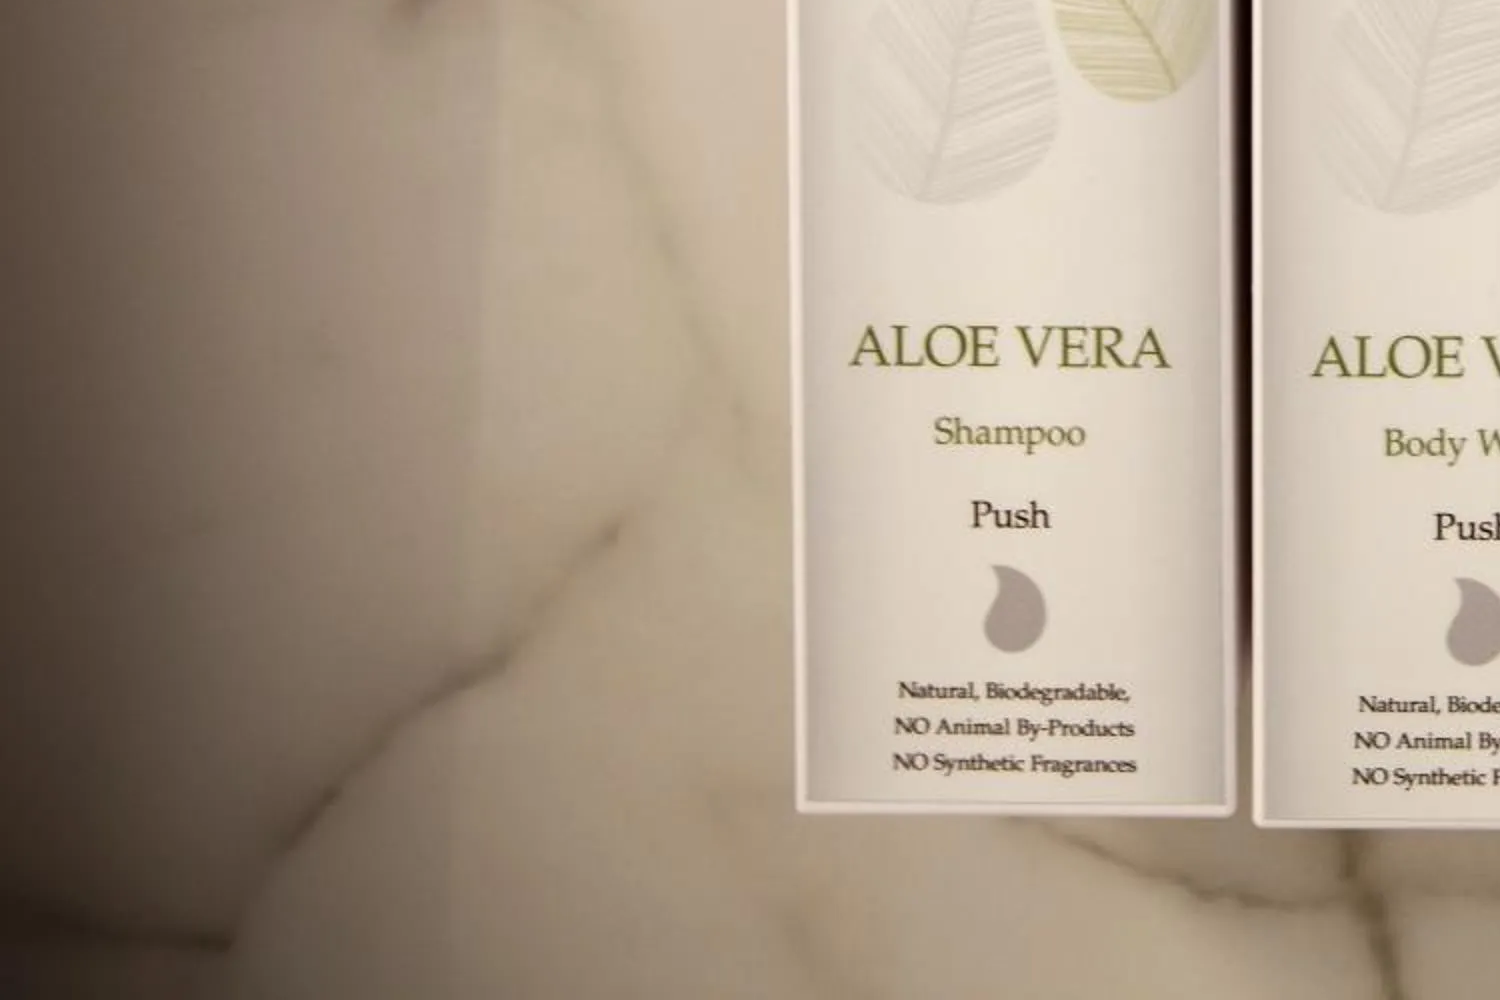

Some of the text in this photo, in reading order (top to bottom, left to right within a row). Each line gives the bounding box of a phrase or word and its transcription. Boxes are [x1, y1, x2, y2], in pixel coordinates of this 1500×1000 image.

[848, 324, 1172, 369] ALOE VERA
[1312, 335, 1464, 378] ALOE
[934, 416, 1085, 454] Shampoo
[1384, 428, 1466, 466] Body
[971, 500, 1051, 529] Push
[898, 681, 1131, 706] Natural, Biodegradable,
[1359, 695, 1441, 716] Natural,
[895, 718, 1135, 741] NO Animal By-Products
[1354, 733, 1390, 749] NO
[1396, 732, 1471, 750] Animal
[892, 753, 1137, 777] NO Synthetic Fragrances
[1352, 768, 1388, 785] NO
[1393, 768, 1486, 789] Synthetic
